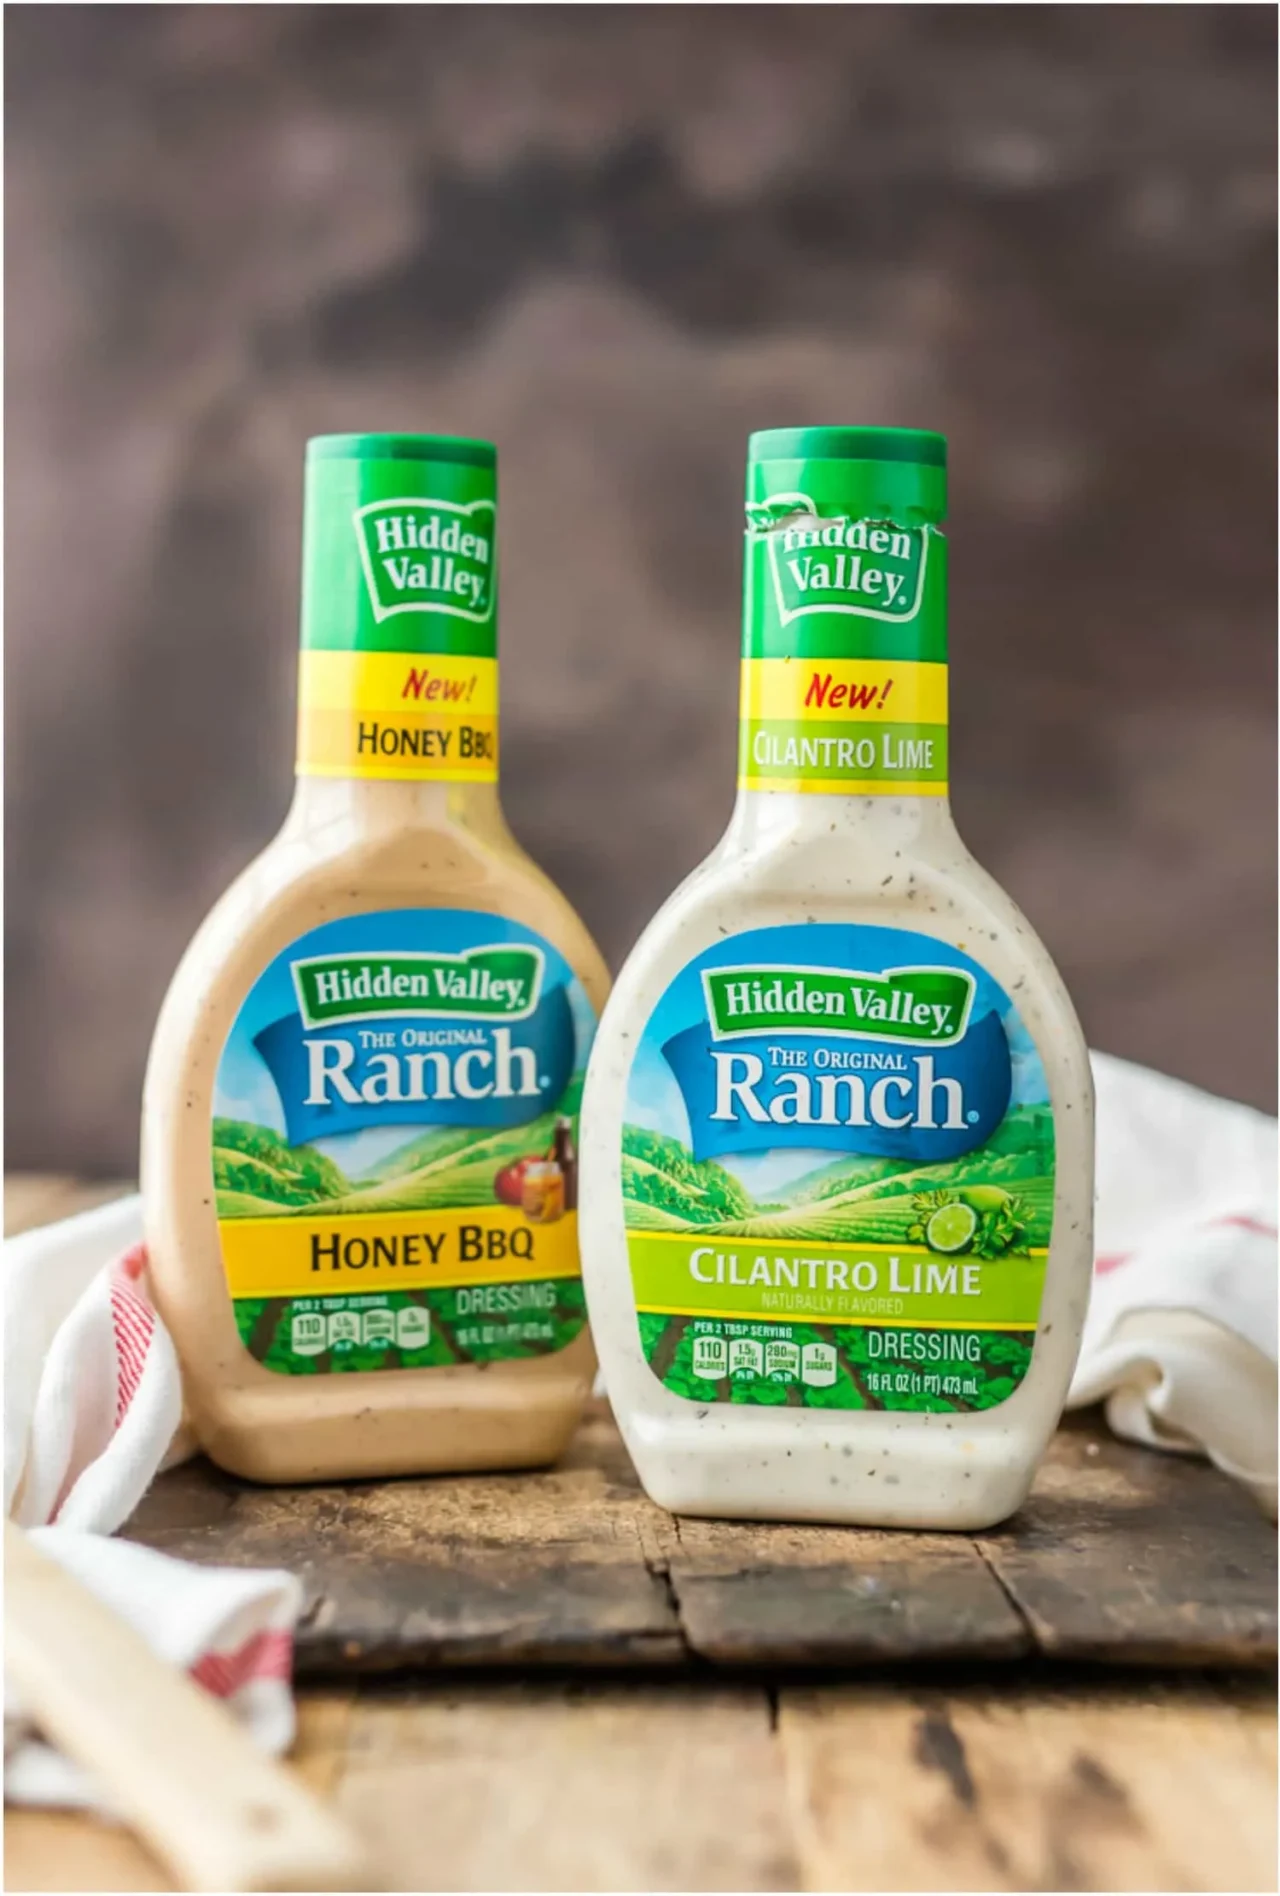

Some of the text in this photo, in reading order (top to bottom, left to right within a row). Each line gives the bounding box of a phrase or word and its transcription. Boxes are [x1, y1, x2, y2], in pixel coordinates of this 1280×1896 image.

[374, 515, 488, 564] Hidden
[402, 668, 477, 703] New!
[805, 673, 893, 710] New!
[358, 722, 453, 758] HONEY
[753, 731, 934, 770] CILANTRO LIME
[314, 965, 429, 1005] Hidden
[725, 981, 845, 1017] Hidden
[358, 1029, 487, 1049] THE ORIGINAL
[302, 1028, 541, 1106] Ranch
[768, 1046, 907, 1071] THE ORIGINAL
[710, 1052, 968, 1130] Ranch
[310, 1225, 534, 1271] HONEY BBQ
[689, 1247, 981, 1296] CILANTRO LIME
[456, 1282, 556, 1315] DRESSING
[762, 1292, 904, 1314] NATURALLY FLAVORED
[298, 1317, 321, 1335] 110
[694, 1322, 793, 1339] PER 2 TBSP SERVING
[699, 1341, 722, 1360] 110
[868, 1331, 981, 1362] DRESSING
[806, 1361, 833, 1372] SUGARS
[867, 1373, 879, 1391] 16
[880, 1374, 893, 1391] FL
[895, 1374, 909, 1392] OZ
[923, 1373, 940, 1396] PT)
[942, 1376, 961, 1395] 473
